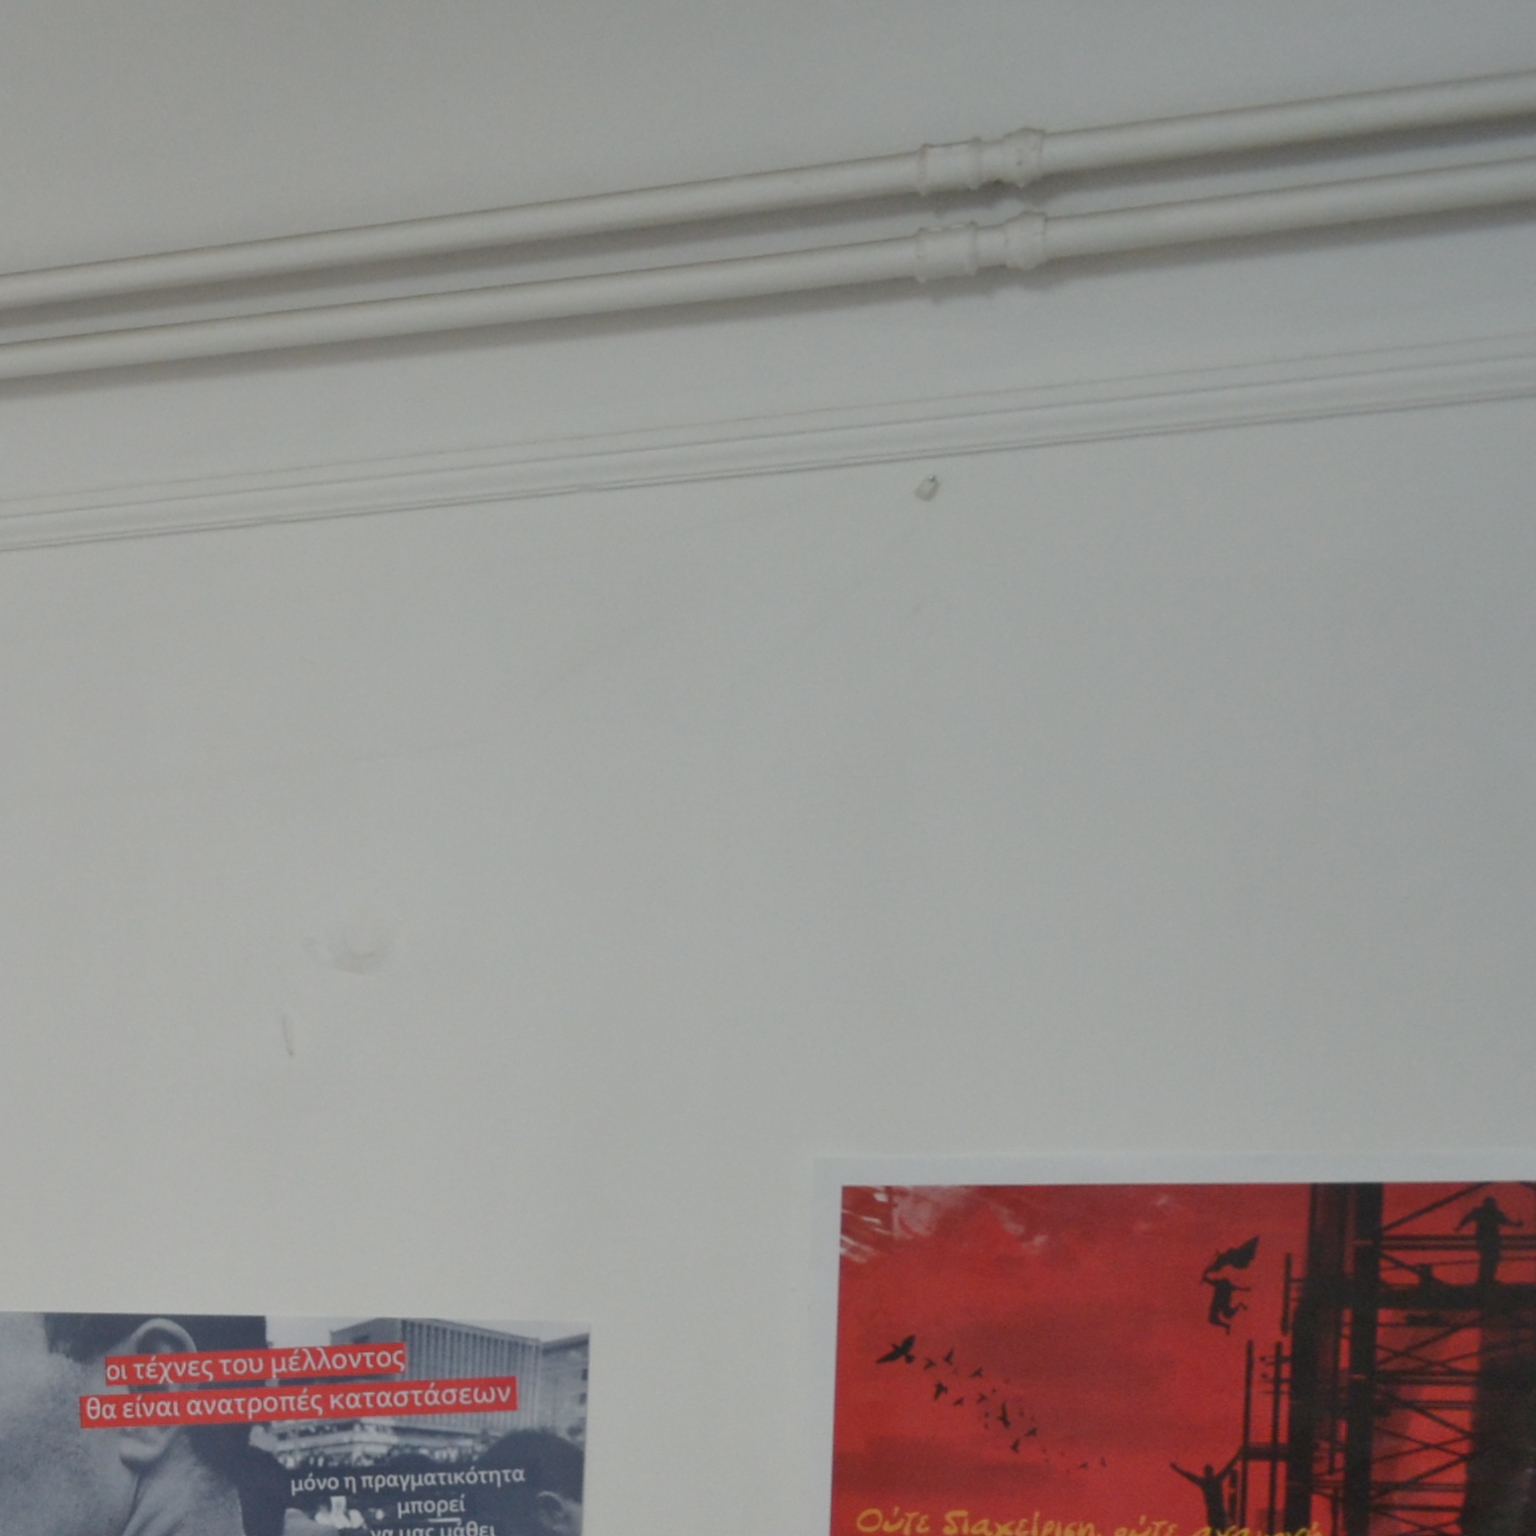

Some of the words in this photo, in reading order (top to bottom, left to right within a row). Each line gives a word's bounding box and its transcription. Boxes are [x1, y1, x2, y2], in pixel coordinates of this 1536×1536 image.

[106, 1363, 127, 1381] οι
[134, 1355, 213, 1385] τέχνες
[220, 1357, 264, 1376] του
[271, 1346, 406, 1378] μέλλοντος
[86, 1396, 117, 1420] θα
[122, 1392, 180, 1418] είναι
[187, 1389, 323, 1419] ανατροπές
[329, 1382, 510, 1411] καταστάσεων
[291, 1473, 339, 1496] μόνο
[344, 1476, 357, 1493] η
[361, 1467, 525, 1492] πραγματικότητα
[397, 1494, 466, 1518] μπορεί
